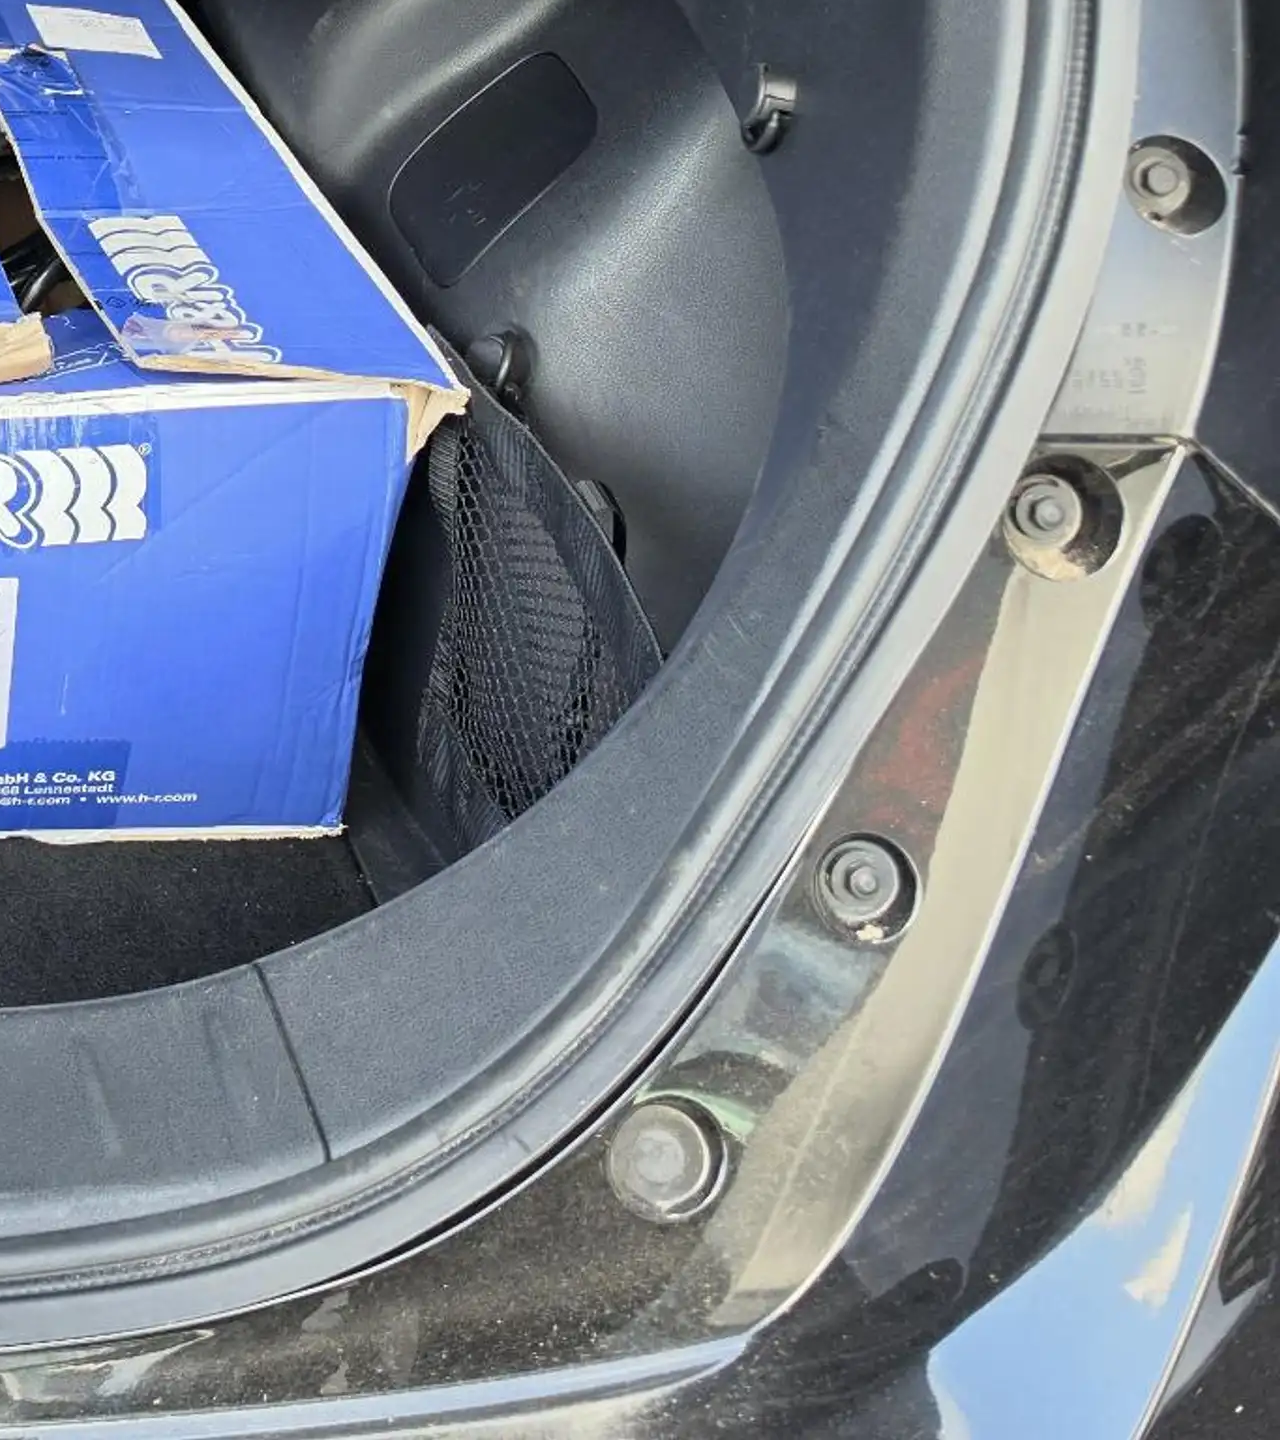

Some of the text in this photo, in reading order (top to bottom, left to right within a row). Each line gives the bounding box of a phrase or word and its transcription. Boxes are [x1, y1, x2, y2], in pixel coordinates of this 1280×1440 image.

[34, 772, 48, 783] &
[52, 772, 82, 783] Co.
[88, 770, 116, 782] KG
[24, 783, 114, 796] Lennestadt
[96, 792, 197, 804] www.h-r.com
